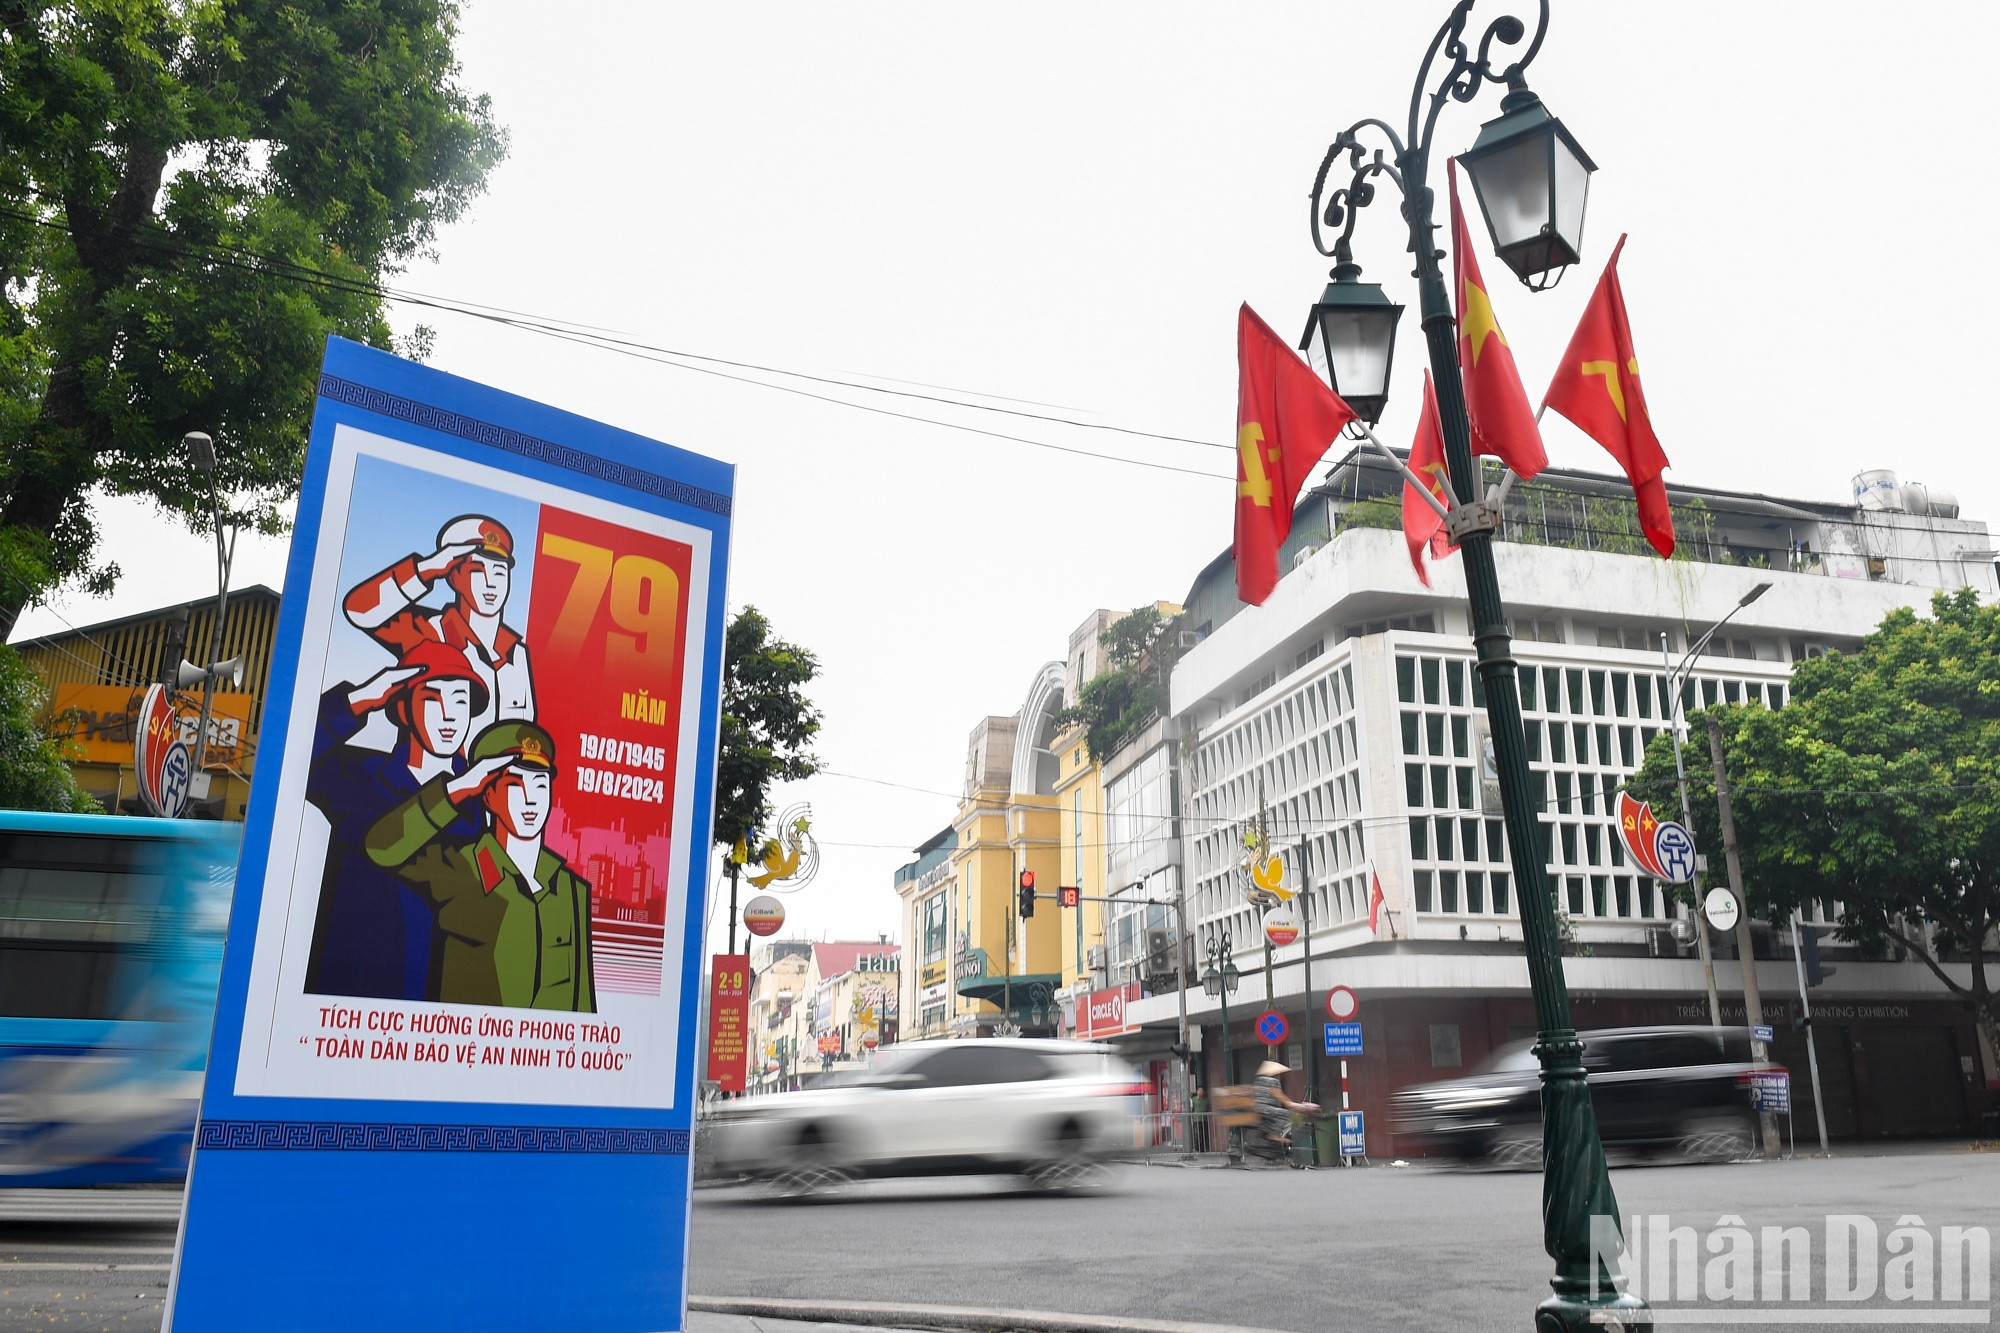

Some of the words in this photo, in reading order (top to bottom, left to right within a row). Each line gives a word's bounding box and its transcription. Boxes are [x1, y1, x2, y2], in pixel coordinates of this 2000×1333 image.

[542, 532, 679, 692] 79
[621, 688, 667, 726] NĂM
[580, 733, 665, 772] 19/8/1945
[576, 767, 664, 804] 19/8/2024
[1064, 890, 1076, 906] 18
[319, 1004, 362, 1030] TÍCH
[367, 1010, 404, 1036] CỰC
[410, 1009, 472, 1036] HƯỞNG
[478, 1012, 514, 1038] ỨNG
[519, 1018, 575, 1041] PHONG
[580, 1016, 622, 1044] TRÀO
[1092, 1002, 1112, 1020] CIRCLE
[1762, 1004, 1784, 1020] HUẬT
[1809, 1006, 1854, 1018] PAINTING
[1858, 1006, 1909, 1018] EXHIBITION
[315, 1034, 364, 1060] TOÀN
[370, 1038, 408, 1062] DÂN
[414, 1038, 449, 1064] BẢO
[456, 1040, 478, 1069] VỆ
[482, 1046, 504, 1066] AN
[510, 1048, 550, 1068] NINH
[556, 1043, 576, 1069] TỔ
